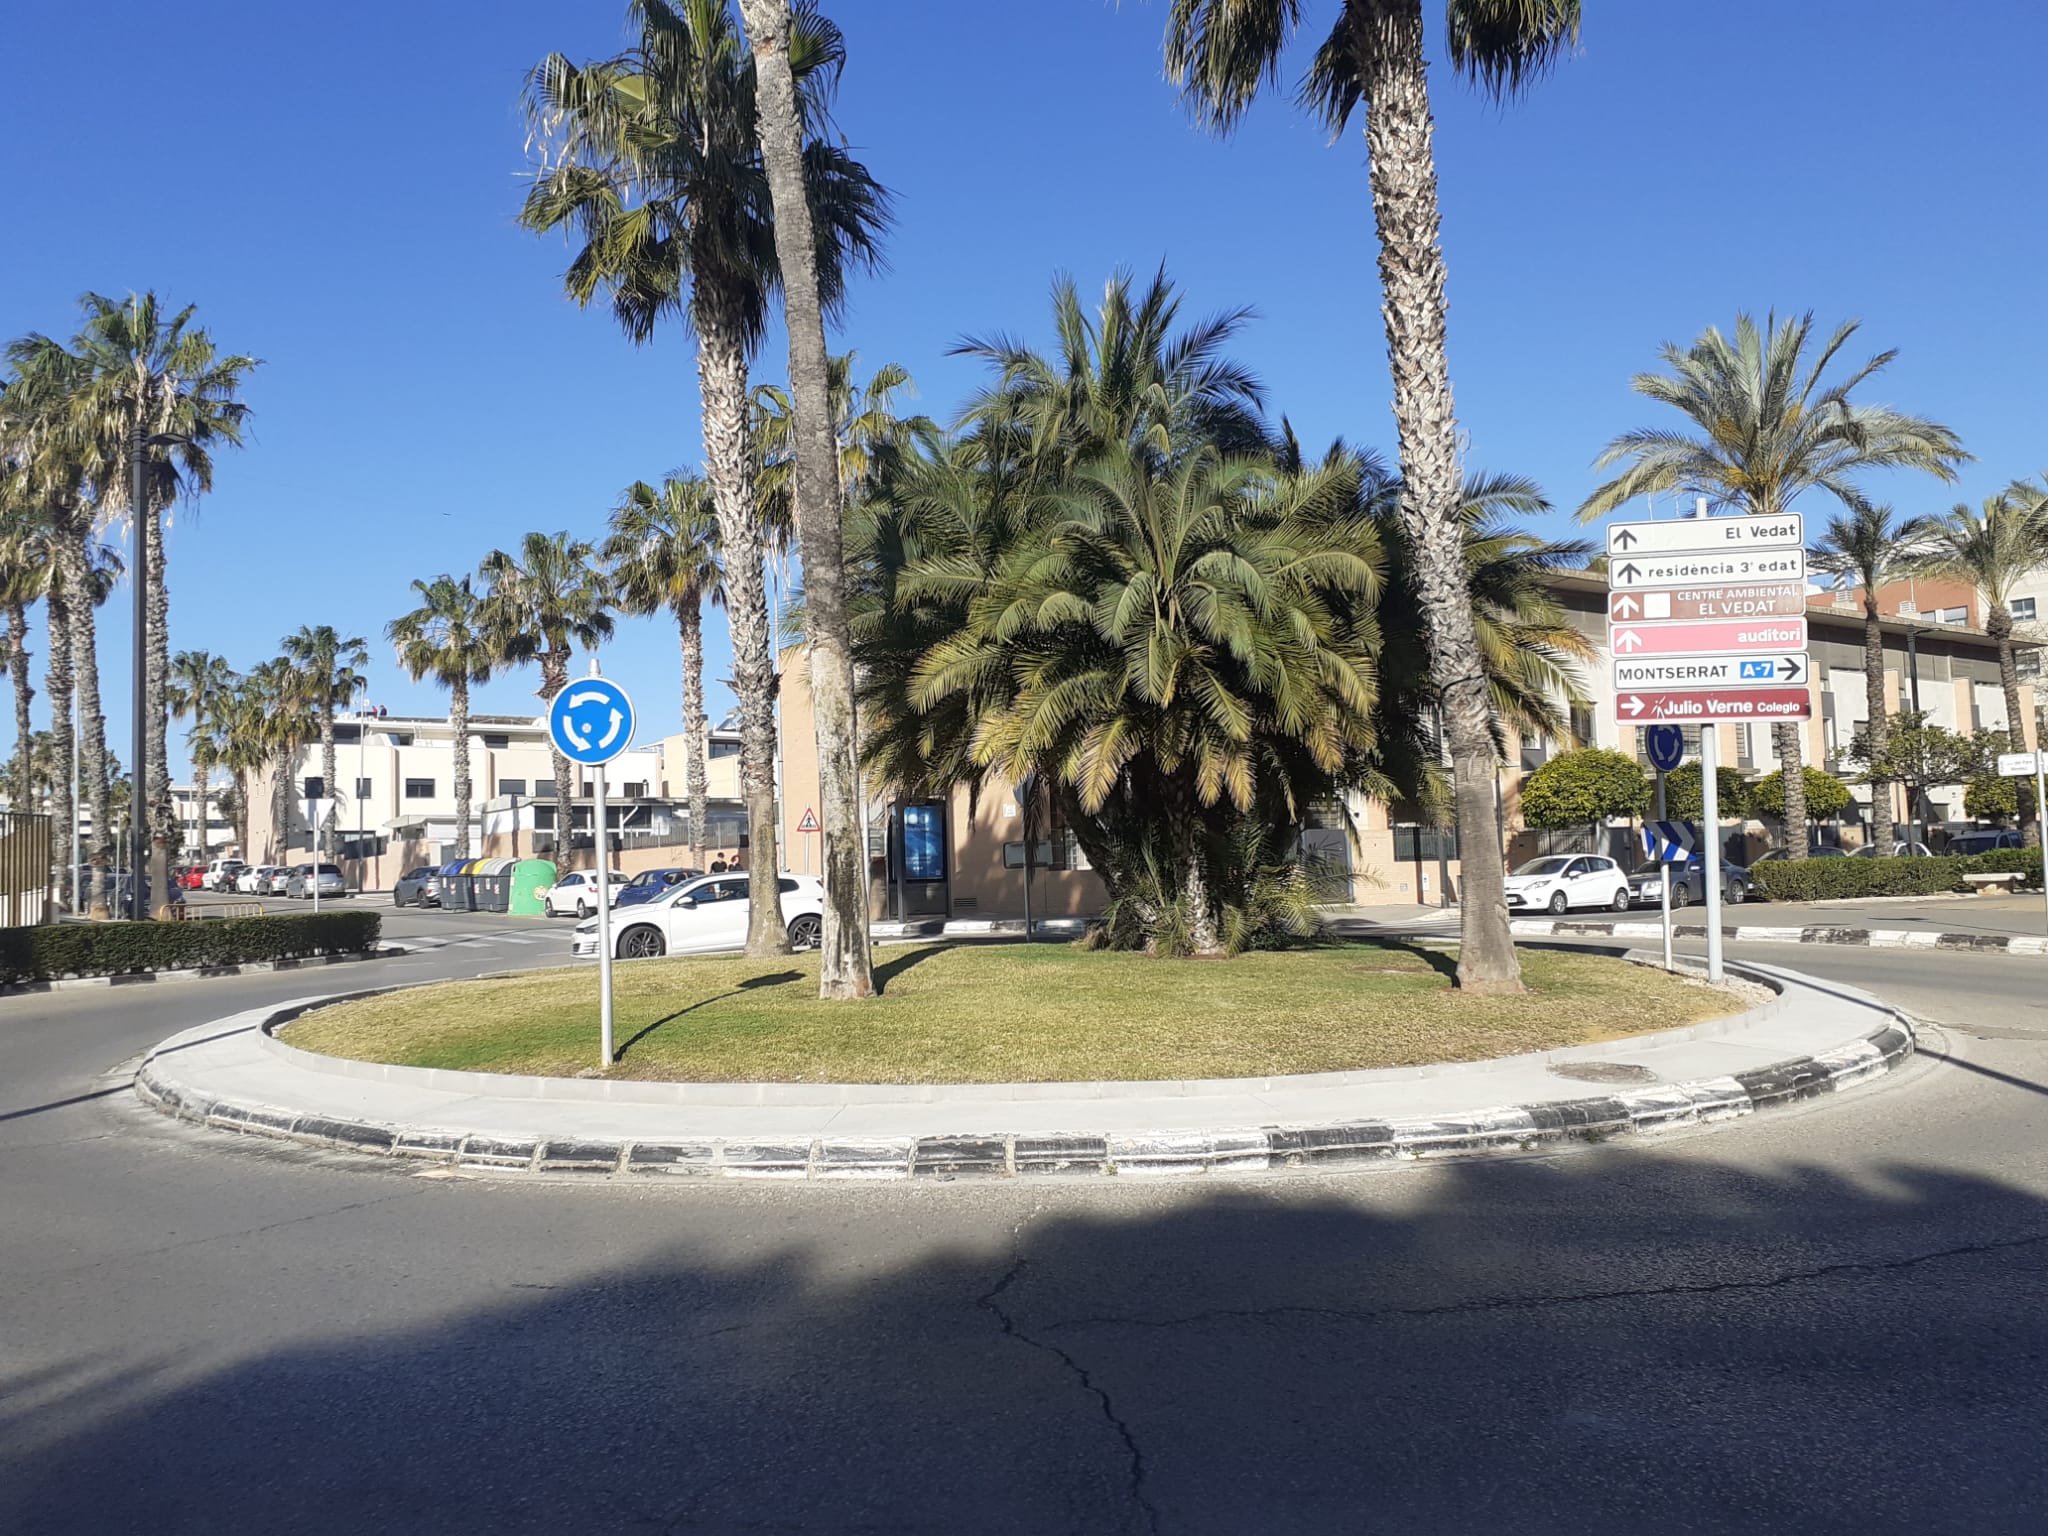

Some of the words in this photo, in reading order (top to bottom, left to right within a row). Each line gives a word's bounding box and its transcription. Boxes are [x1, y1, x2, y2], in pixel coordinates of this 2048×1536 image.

[1726, 527, 1741, 539] El
[1750, 523, 1796, 538] Vedat
[1758, 560, 1796, 572] edat
[1677, 589, 1723, 601] CENTRE
[1726, 584, 1798, 599] AMBIENTAL
[1699, 603, 1716, 615] EL
[1721, 600, 1776, 614] VEDAT
[1737, 628, 1800, 643] auditori
[1618, 665, 1728, 680] MONTSERRAT
[1742, 662, 1772, 677] A-7
[1664, 700, 1703, 715] Julio
[1706, 699, 1753, 713] Verne
[1757, 701, 1800, 714] Colegio
